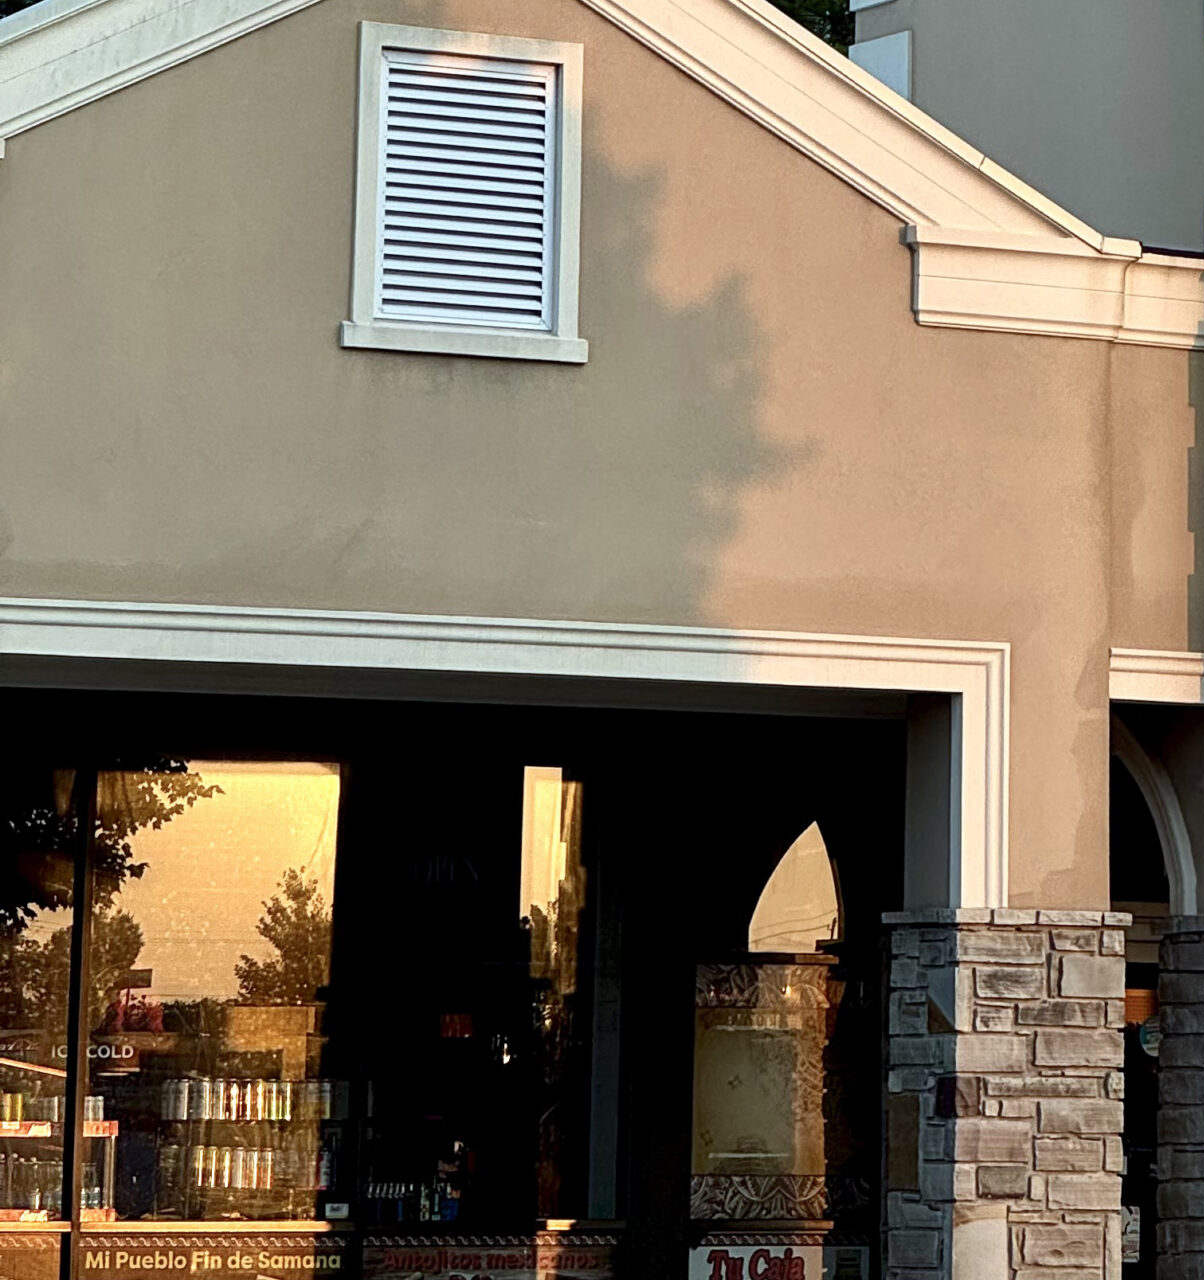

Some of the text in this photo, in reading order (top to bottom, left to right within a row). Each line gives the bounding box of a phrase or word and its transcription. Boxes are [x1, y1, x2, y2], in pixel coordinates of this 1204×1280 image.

[86, 1045, 134, 1059] COLD
[85, 1251, 341, 1269] Mi Pueblo Fin de Samana
[383, 1251, 599, 1273] Antojitos mexicanos
[707, 1247, 805, 1280] Tu Caja
